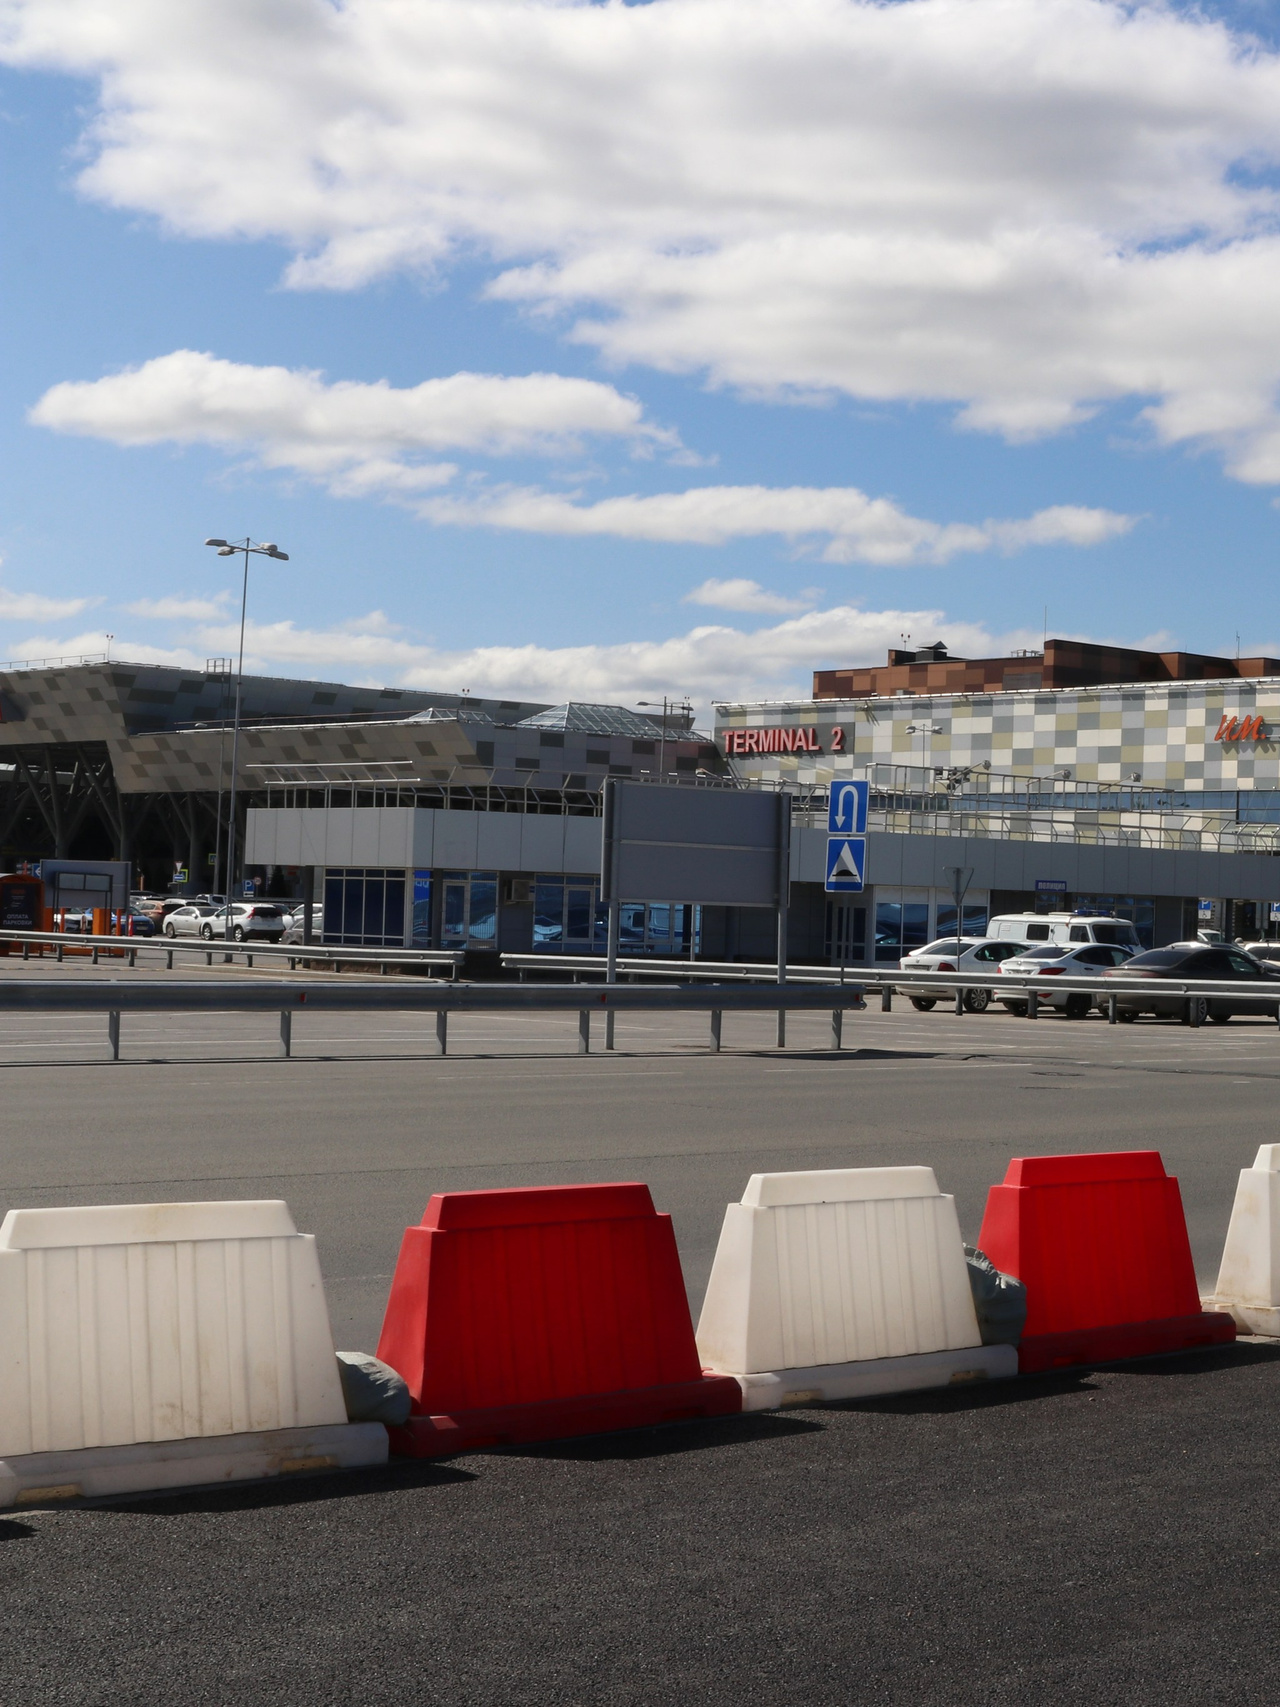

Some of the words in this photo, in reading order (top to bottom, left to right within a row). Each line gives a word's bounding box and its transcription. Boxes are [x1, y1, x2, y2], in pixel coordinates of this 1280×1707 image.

[722, 728, 821, 753] TERMINAL
[830, 726, 843, 751] 2
[1214, 713, 1266, 742] им.
